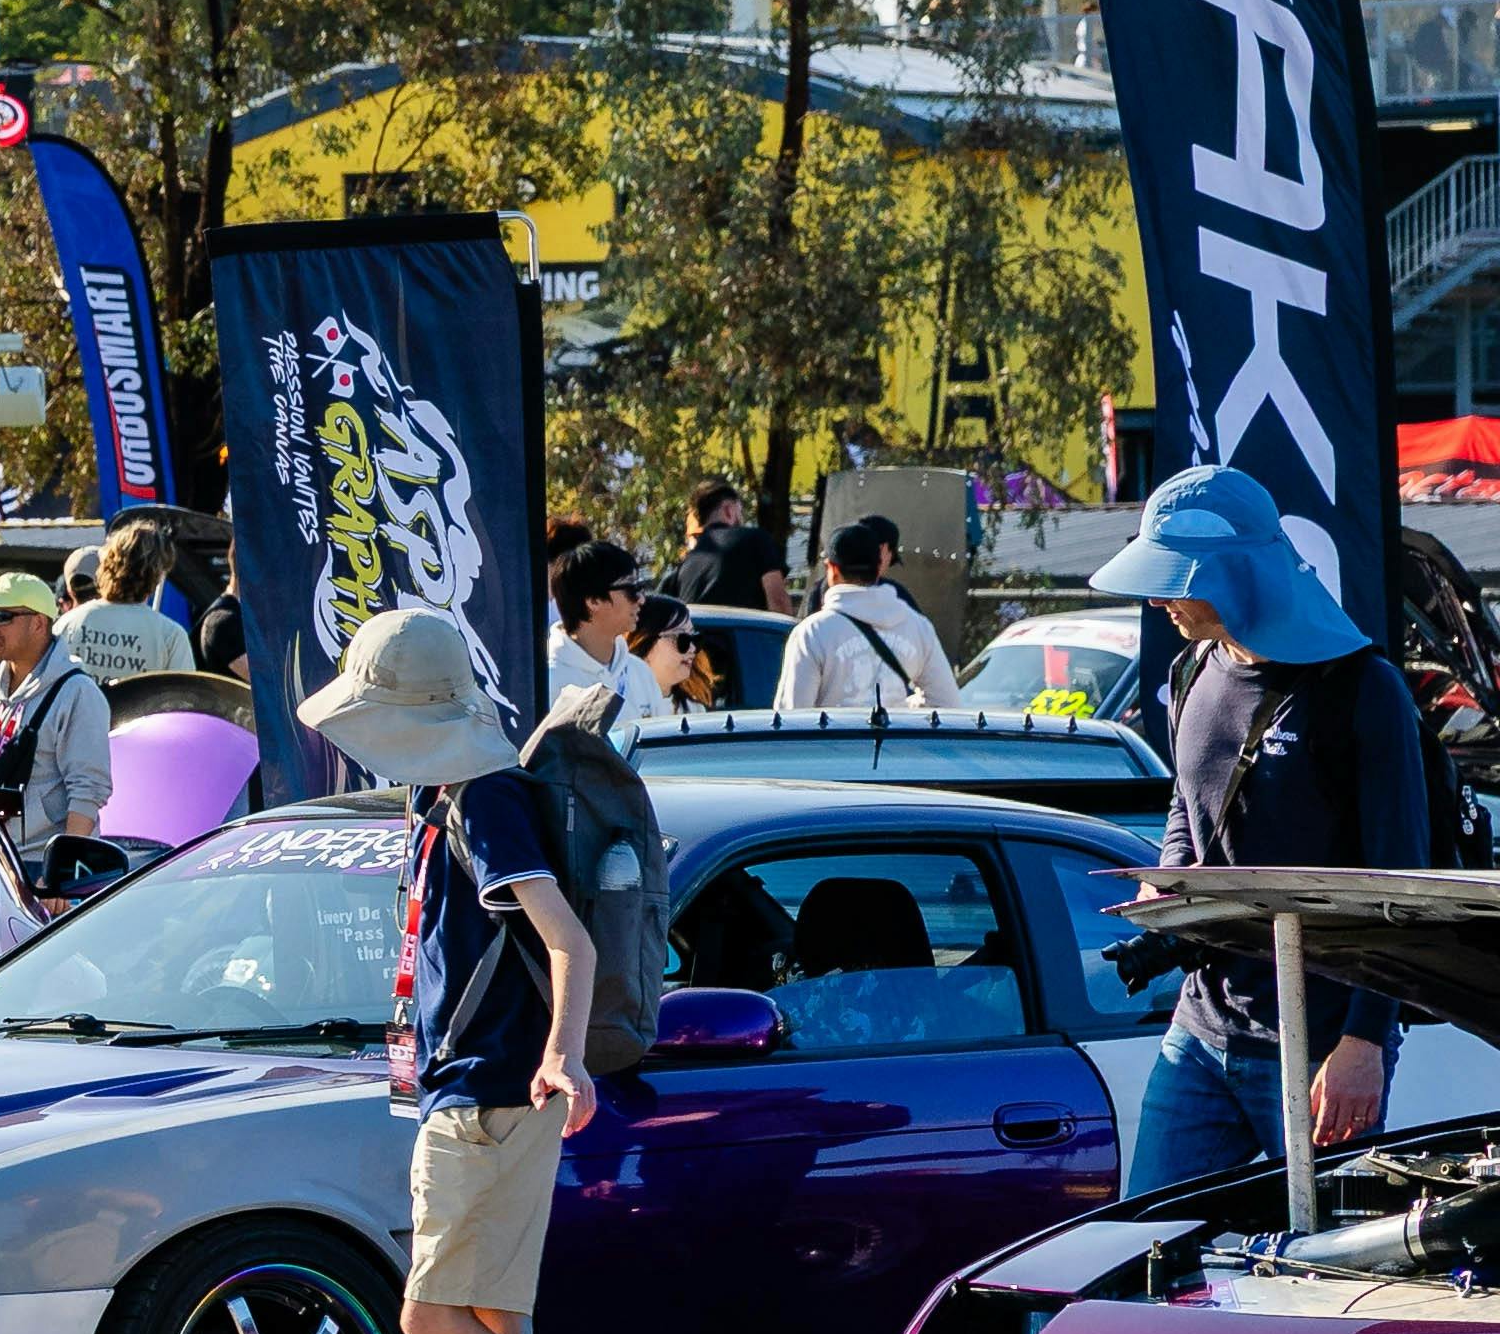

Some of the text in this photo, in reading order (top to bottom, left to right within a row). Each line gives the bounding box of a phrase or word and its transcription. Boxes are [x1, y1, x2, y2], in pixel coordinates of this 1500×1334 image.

[261, 333, 292, 486] THE CANVAS
[291, 451, 321, 546] IGNITES
[373, 405, 458, 612] ASP
[81, 625, 143, 653] know,
[239, 827, 410, 855] UNDERG
[400, 933, 419, 976] GCG
